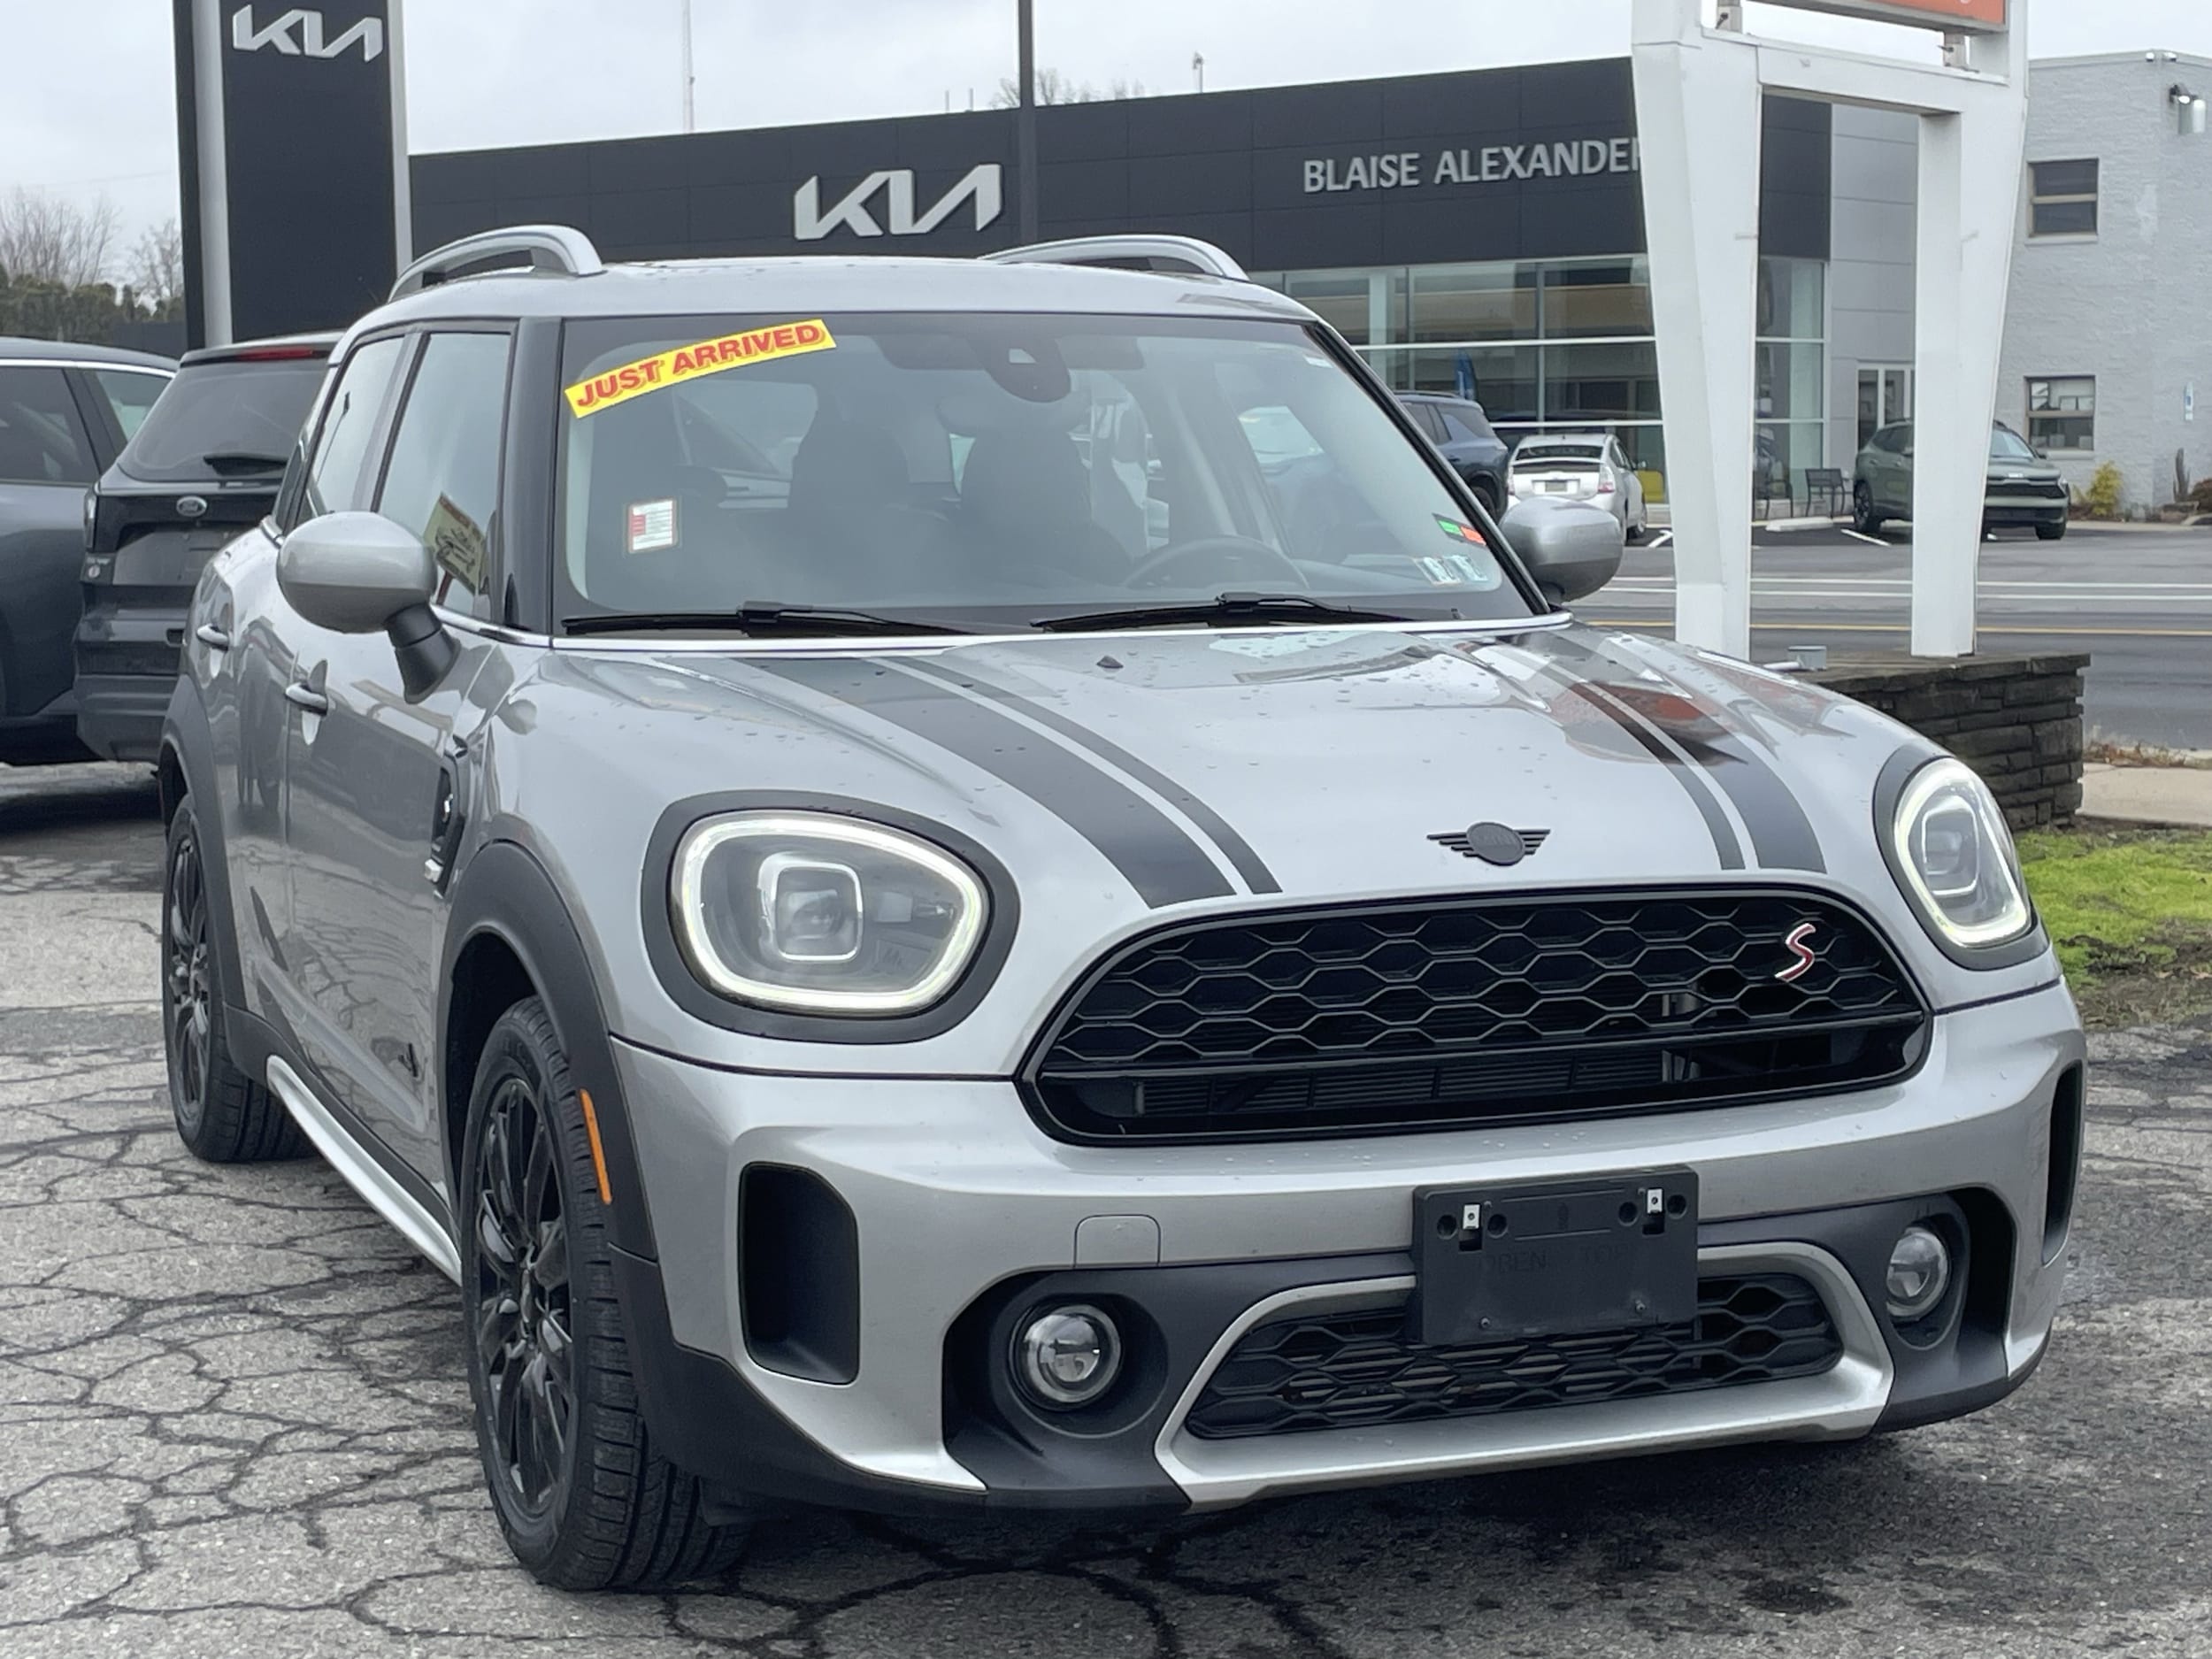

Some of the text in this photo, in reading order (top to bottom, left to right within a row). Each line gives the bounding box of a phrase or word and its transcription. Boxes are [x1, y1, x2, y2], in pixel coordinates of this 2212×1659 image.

[233, 4, 383, 63] KIA
[795, 163, 1002, 241] KIA
[1303, 152, 1421, 193] BLAISE
[577, 324, 826, 408] JUST ARRIVED
[1774, 923, 1816, 982] S
